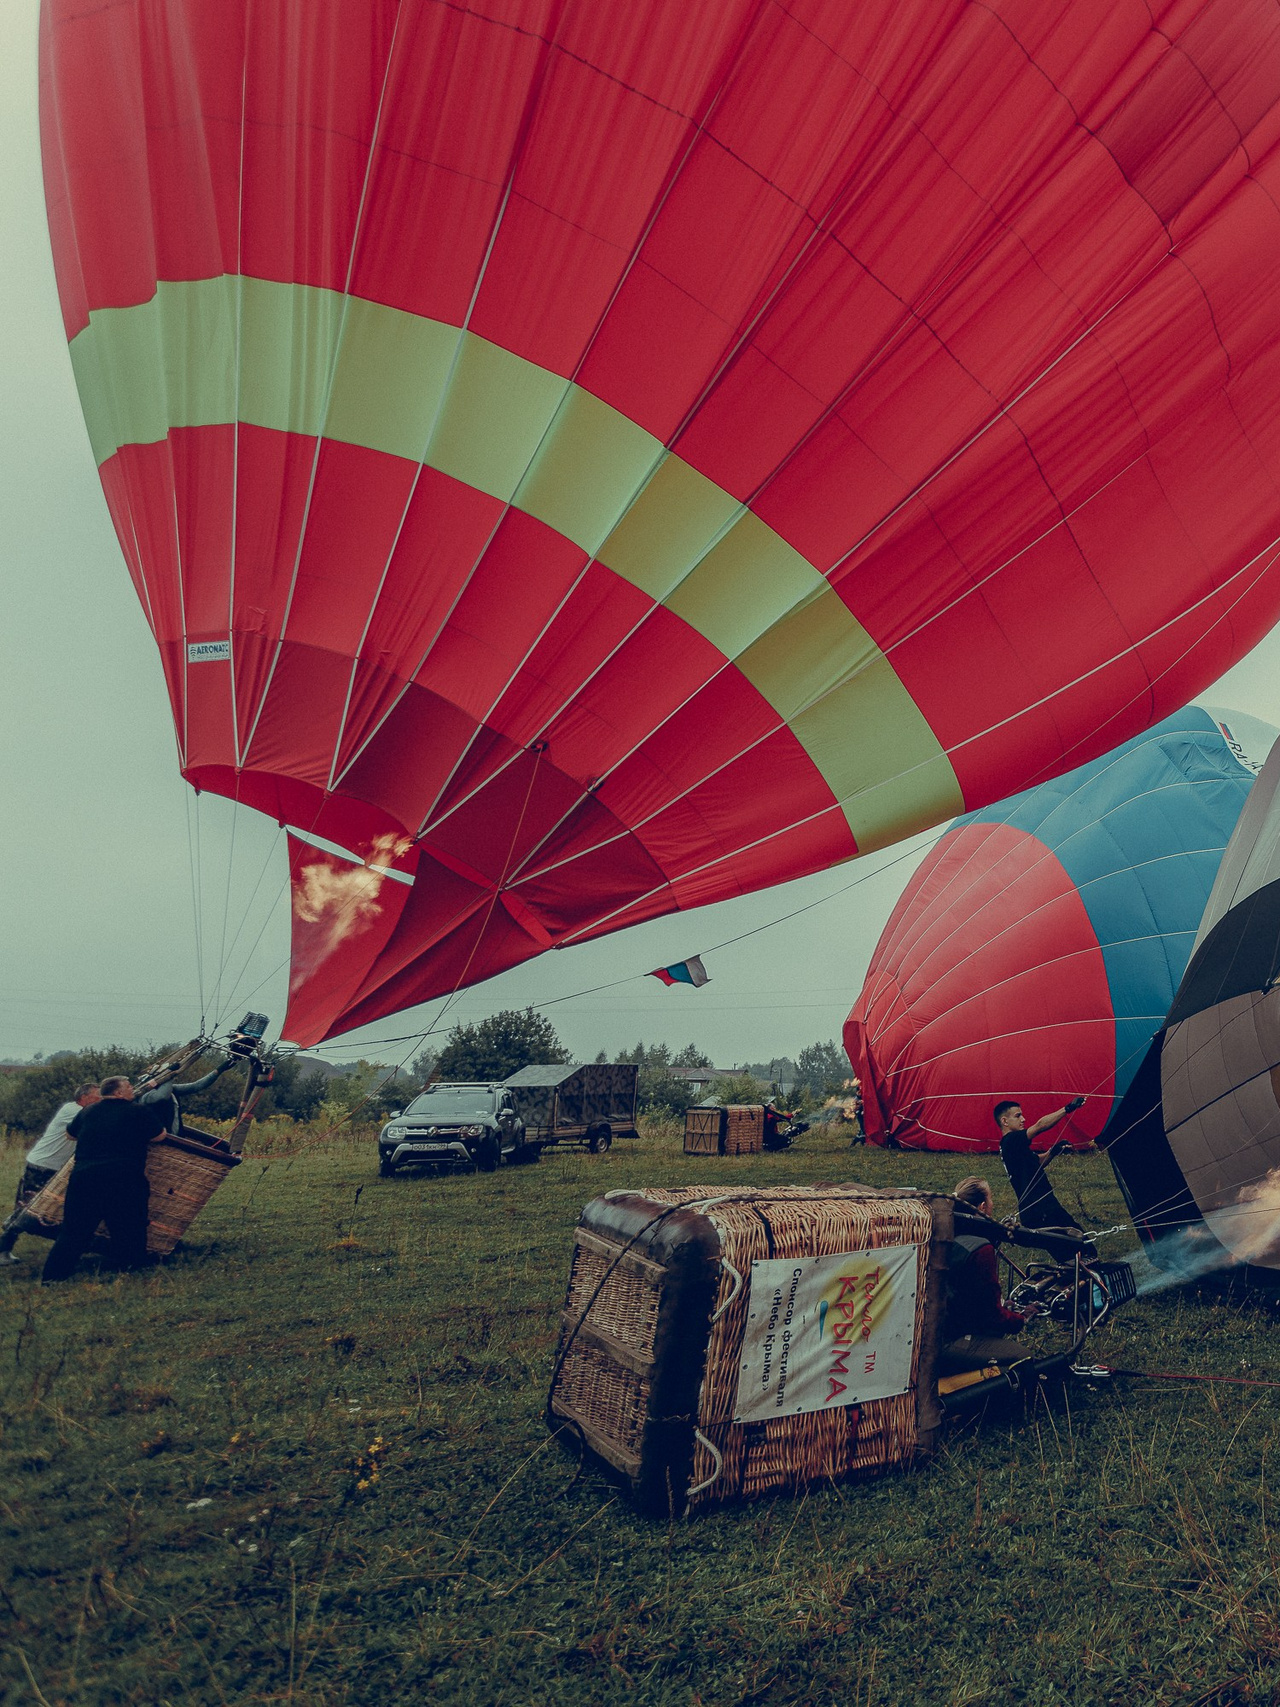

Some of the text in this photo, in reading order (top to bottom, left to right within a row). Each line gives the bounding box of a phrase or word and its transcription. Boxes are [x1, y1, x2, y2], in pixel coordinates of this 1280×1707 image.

[768, 1288, 783, 1330] «Небо
[776, 1268, 803, 1407] Спонсор фестиваля
[825, 1276, 859, 1402] КРЫМА
